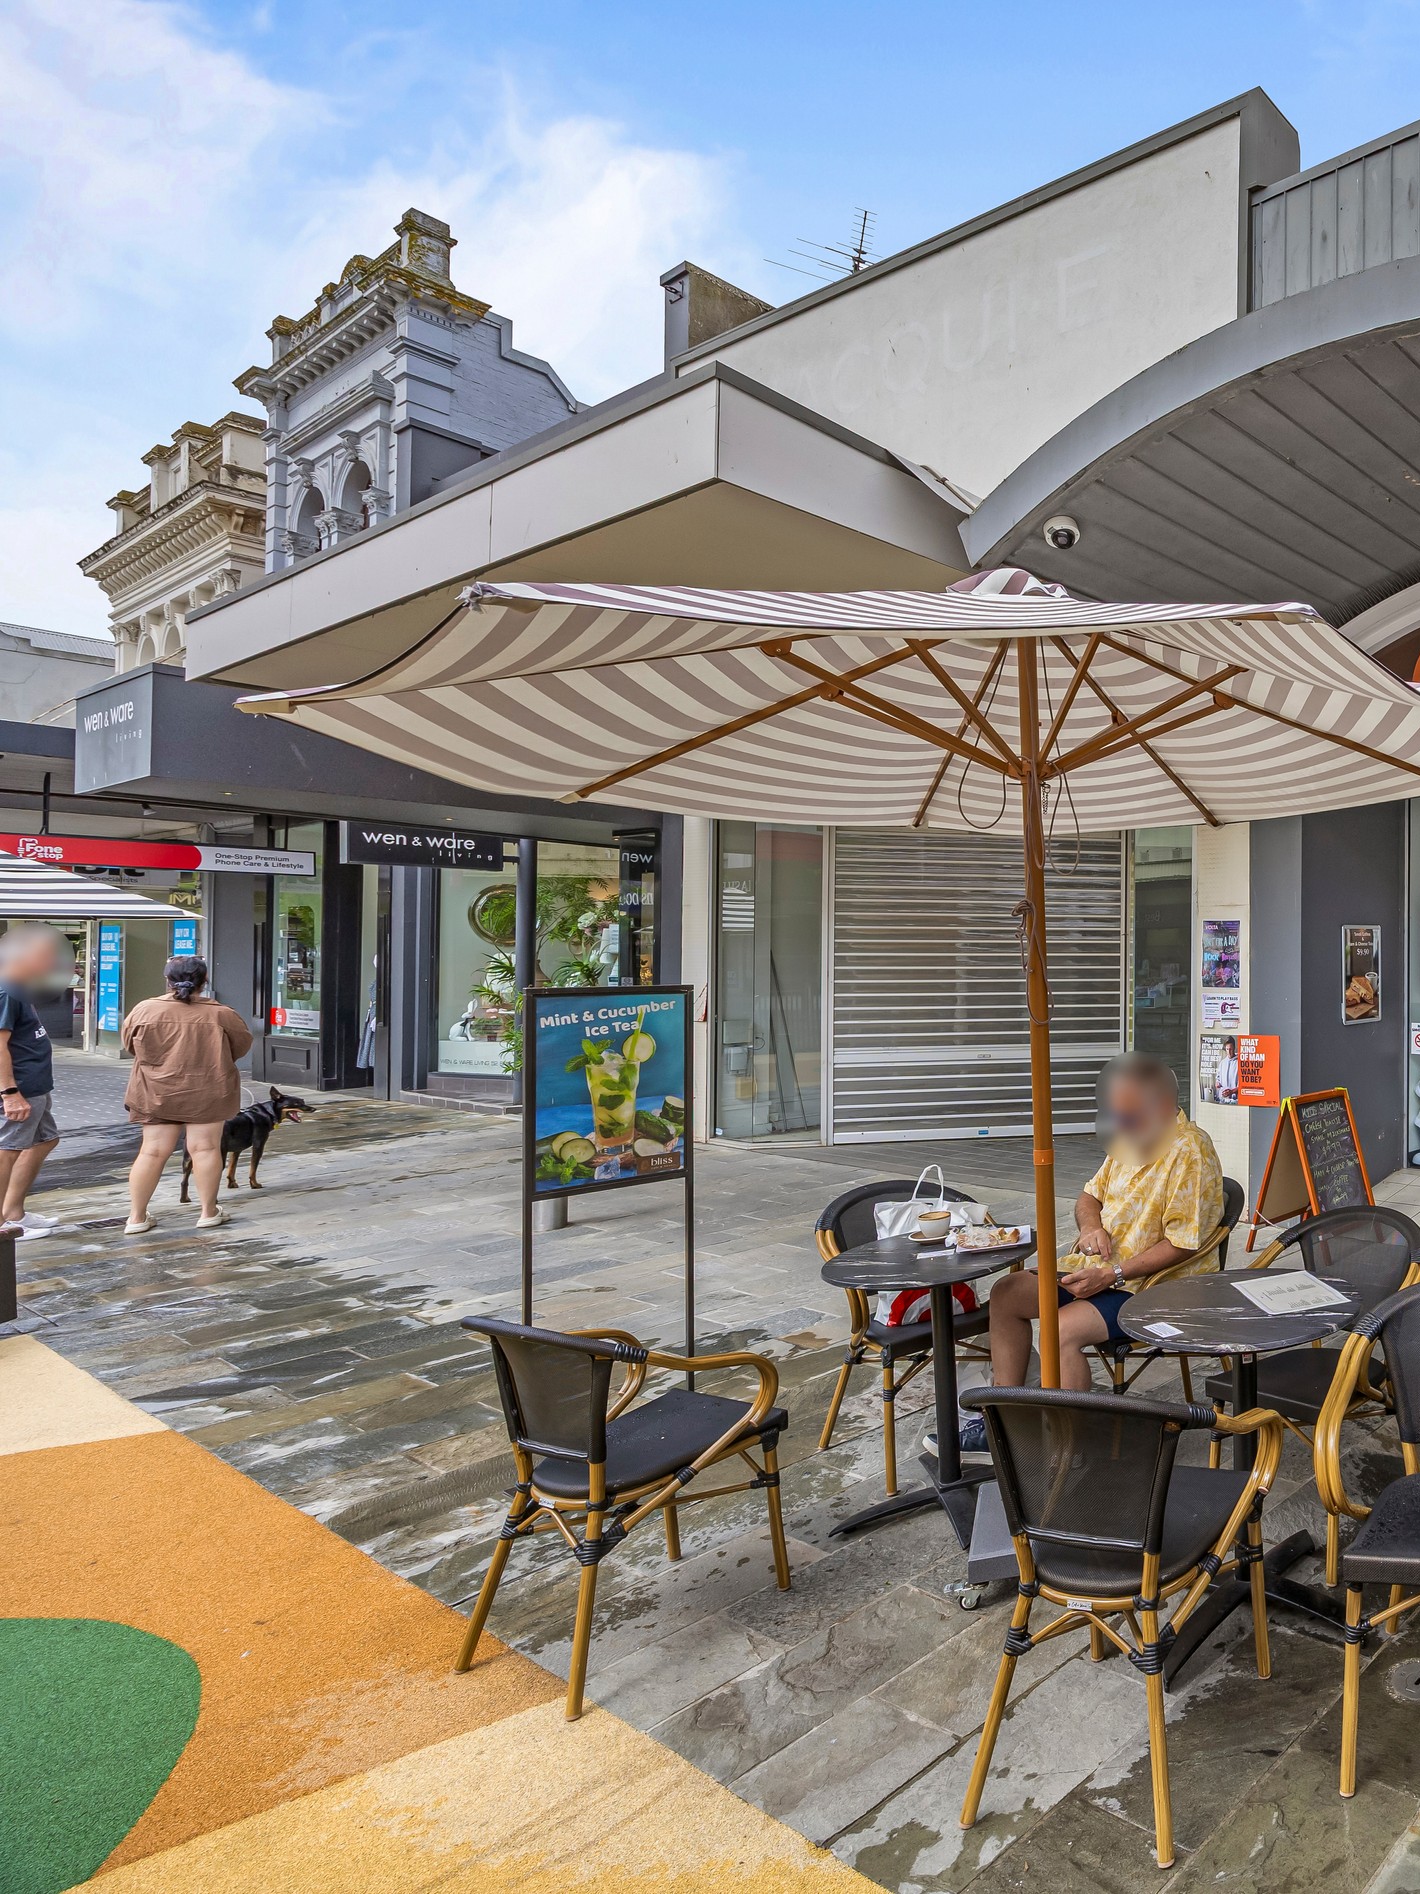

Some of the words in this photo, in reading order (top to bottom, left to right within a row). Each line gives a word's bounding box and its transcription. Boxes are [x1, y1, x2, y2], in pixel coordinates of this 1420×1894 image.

[84, 711, 103, 733] wen
[104, 711, 109, 727] &
[110, 701, 134, 725] ware
[115, 729, 142, 743] living
[362, 831, 407, 846] wen
[411, 836, 422, 847] &
[426, 835, 475, 850] ware
[25, 843, 63, 854] Fone
[37, 852, 64, 860] stop
[215, 852, 253, 861] One-Stop
[439, 850, 493, 861] living
[272, 862, 304, 870] Lifestyle
[88, 875, 139, 884] Specialists
[1356, 948, 1370, 956] $9.90
[540, 1013, 579, 1029] Mint
[582, 1010, 595, 1022] &
[597, 1000, 676, 1019] Cucumber
[585, 1025, 609, 1037] Ice
[611, 1020, 640, 1032] Tea
[1240, 1038, 1259, 1046] WHAT
[651, 1156, 673, 1166] bliss
